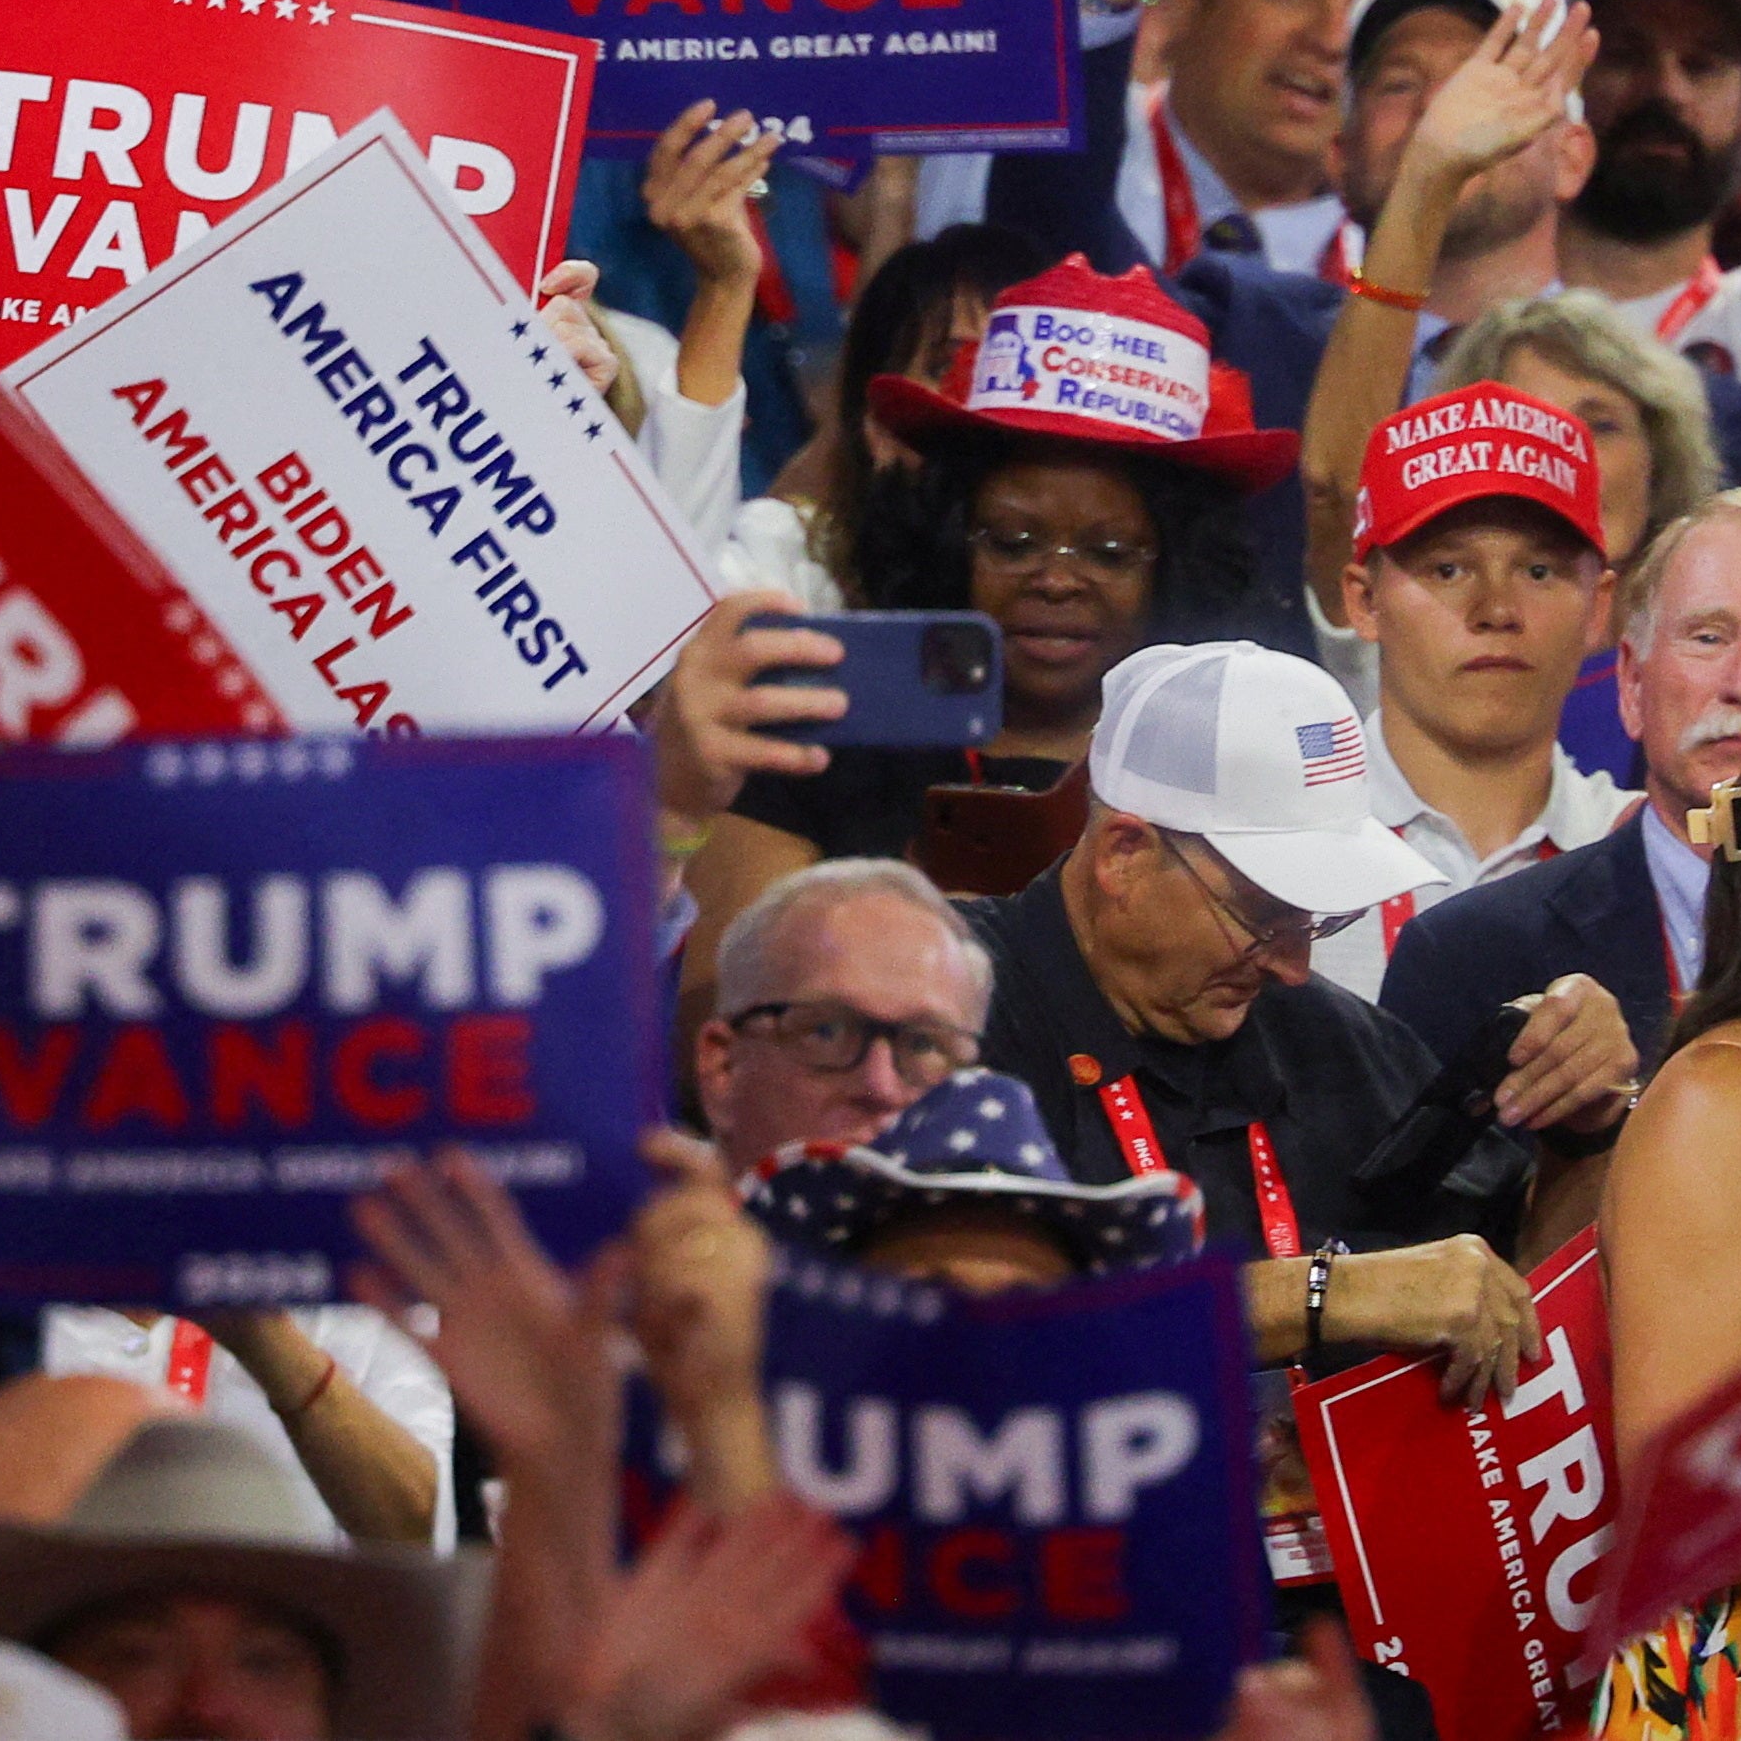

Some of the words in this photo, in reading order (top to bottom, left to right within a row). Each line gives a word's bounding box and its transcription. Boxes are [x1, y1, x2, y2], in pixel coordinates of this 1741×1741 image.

[616, 36, 760, 62] AMERICA
[769, 31, 874, 59] GREAT
[881, 28, 998, 55] AGAIN!
[111, 377, 325, 644] AMERICA
[248, 270, 464, 537] AMERICA
[452, 530, 590, 692] FIRST
[395, 337, 558, 540] TRUMP
[1385, 401, 1466, 455] MAKE
[1468, 398, 1588, 463] AMERICA
[1402, 441, 1493, 490] GREAT
[1497, 443, 1577, 496] AGAIN
[254, 449, 416, 644] BIDEN
[772, 1376, 1202, 1526] UMP
[1464, 1408, 1503, 1489] MAKE
[1488, 1498, 1536, 1632] AMERICA
